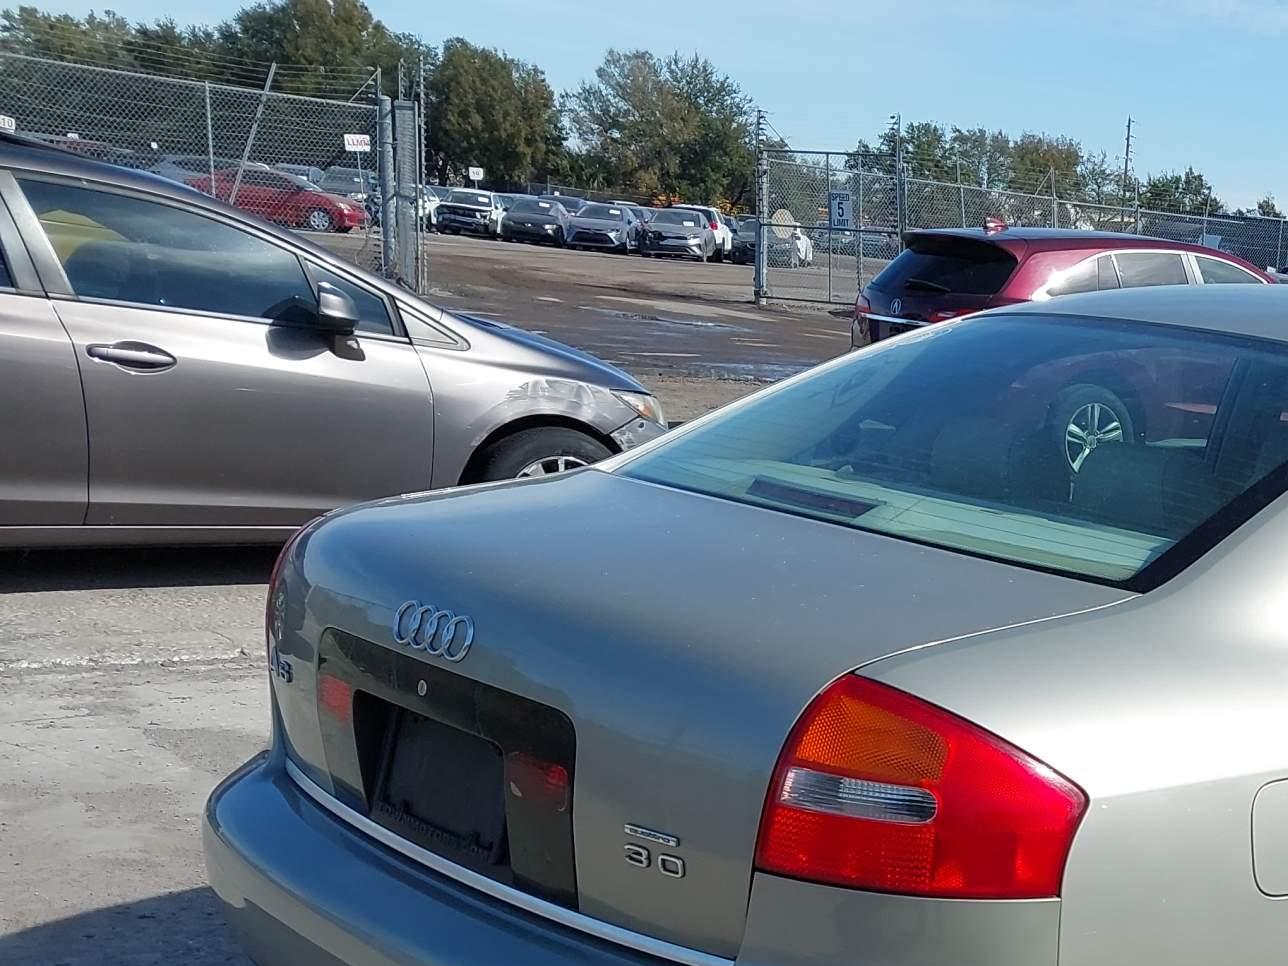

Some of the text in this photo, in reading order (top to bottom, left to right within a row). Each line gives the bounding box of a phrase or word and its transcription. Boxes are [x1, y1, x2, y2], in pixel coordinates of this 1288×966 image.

[831, 192, 850, 201] SPEED
[837, 202, 845, 217] 5
[833, 218, 849, 227] LIMIT
